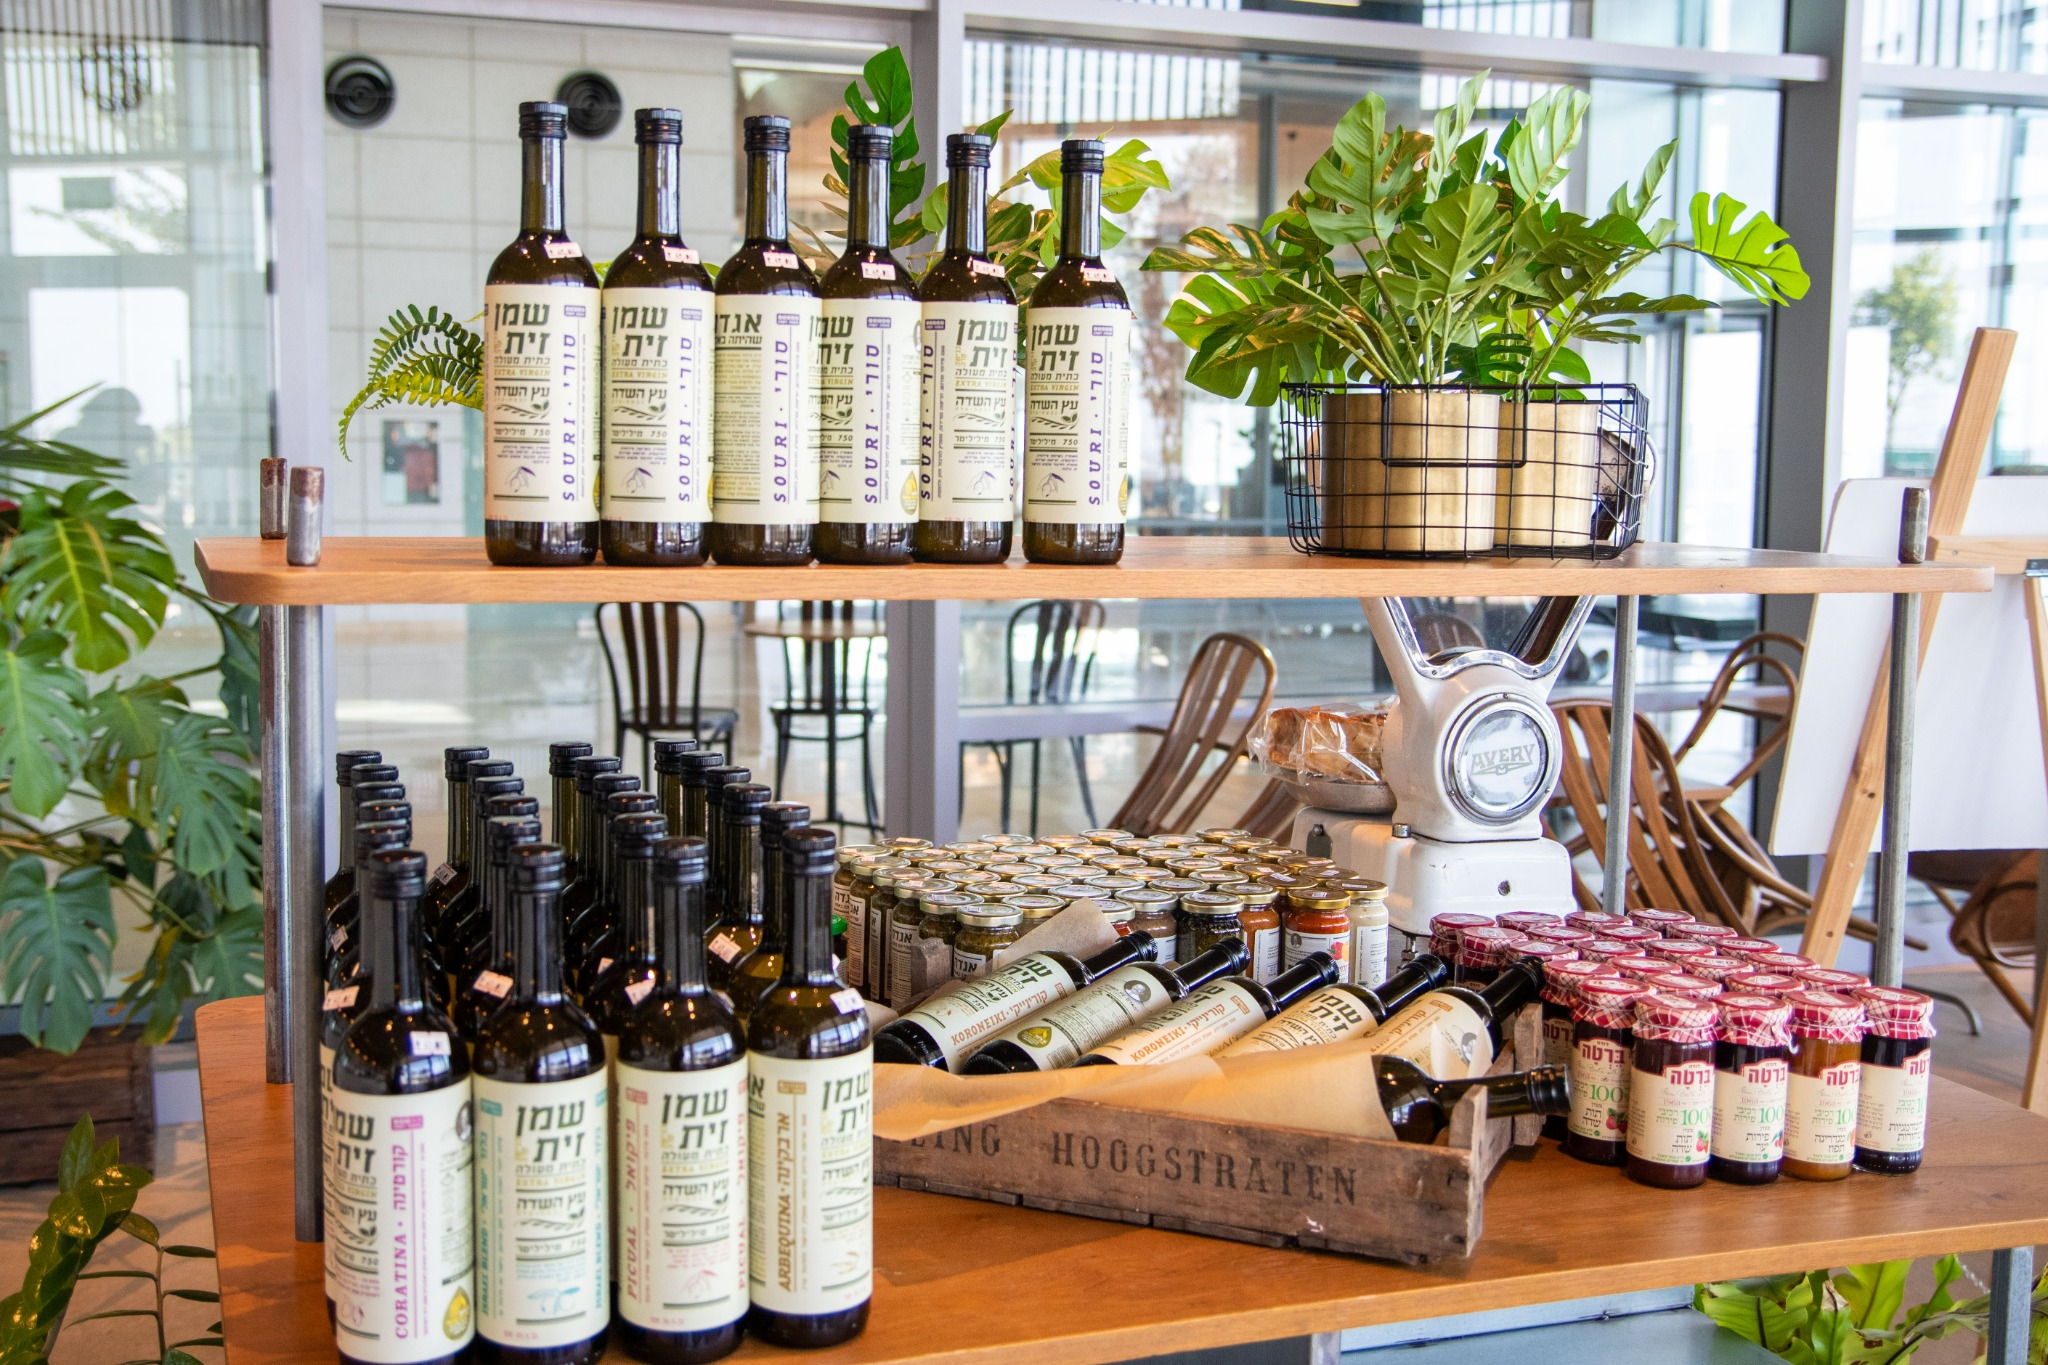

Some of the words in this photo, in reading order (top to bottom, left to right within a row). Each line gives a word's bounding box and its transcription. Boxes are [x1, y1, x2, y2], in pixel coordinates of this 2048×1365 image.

[494, 303, 550, 331] שמן
[612, 306, 668, 334] שמן
[504, 331, 551, 355] זית
[622, 334, 668, 357] זית
[957, 319, 1008, 346] שמן
[1031, 324, 1080, 351] שמן
[563, 334, 576, 387] סורי
[680, 337, 693, 390] סורי
[774, 341, 788, 392] סורי
[865, 344, 879, 396] סורי
[922, 345, 933, 395] סורי
[969, 346, 1008, 368] זית
[1039, 350, 1080, 372] זית
[955, 368, 985, 377] מעולה
[1030, 372, 1052, 381] מעולה
[1055, 373, 1079, 381] כתית
[1090, 352, 1103, 401] סורי
[494, 386, 527, 397] השדה
[531, 387, 549, 401] עץ
[611, 388, 645, 399] השדה
[649, 389, 667, 403] עץ
[836, 394, 853, 409] עץ
[955, 396, 992, 407] השדה
[1051, 384, 1079, 392] VIRGIN
[1030, 399, 1058, 410] השדה
[1061, 400, 1078, 414] עץ
[563, 418, 575, 501] SOURI
[679, 420, 691, 502] SOURI
[774, 421, 787, 503] SOURI
[864, 424, 878, 504] SOURI
[921, 422, 932, 500] SOURI
[1088, 428, 1102, 506] SOURI
[1471, 744, 1536, 769] AVERY
[1309, 993, 1363, 1024] שמן
[1309, 1005, 1349, 1032] זית
[951, 1010, 1008, 1046] KORONEIKI
[1130, 1026, 1187, 1062] KORONEIKI
[662, 1087, 728, 1124] שמן
[1590, 1083, 1625, 1103] 100
[516, 1100, 585, 1137] שמן
[1681, 1107, 1709, 1127] 100
[533, 1131, 585, 1163] זית
[679, 1119, 728, 1150] זית
[1745, 1132, 1770, 1142] פירות
[337, 1142, 376, 1174] זית
[777, 1112, 794, 1186] ארבקינה
[392, 1144, 408, 1211] קורטינה
[1052, 1131, 1357, 1205] HOOGSTRATEN
[516, 1196, 564, 1210] השדה
[662, 1183, 708, 1197] השדה
[778, 1193, 796, 1293] ARBEQUINA
[627, 1225, 637, 1300] PICUAL
[394, 1233, 409, 1340] CORATINA
